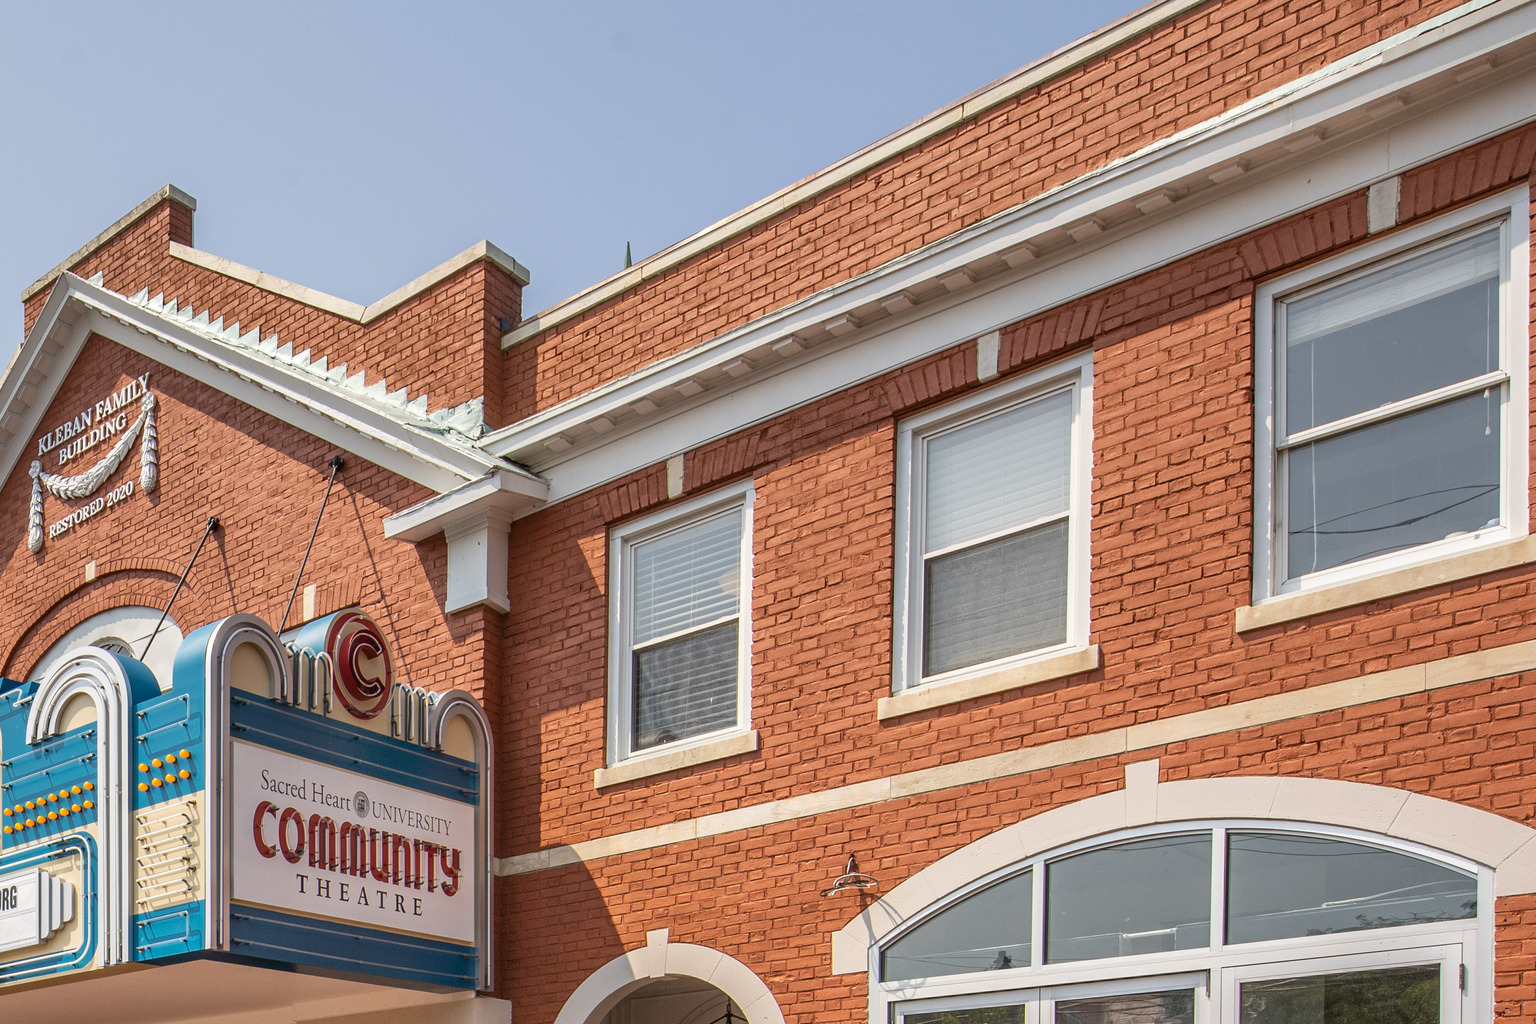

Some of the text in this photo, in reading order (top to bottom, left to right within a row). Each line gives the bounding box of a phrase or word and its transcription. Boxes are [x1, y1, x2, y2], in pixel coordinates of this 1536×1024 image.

[37, 372, 151, 457] KLEBAN FAMILY
[58, 413, 127, 465] BUILDING
[49, 481, 134, 539] RESTORED 2020
[261, 769, 307, 801] Sacred
[312, 782, 352, 812] Heart
[372, 802, 452, 837] UNIVERSITY
[253, 801, 462, 897] COMMUNITY
[296, 874, 423, 916] THEATRE
